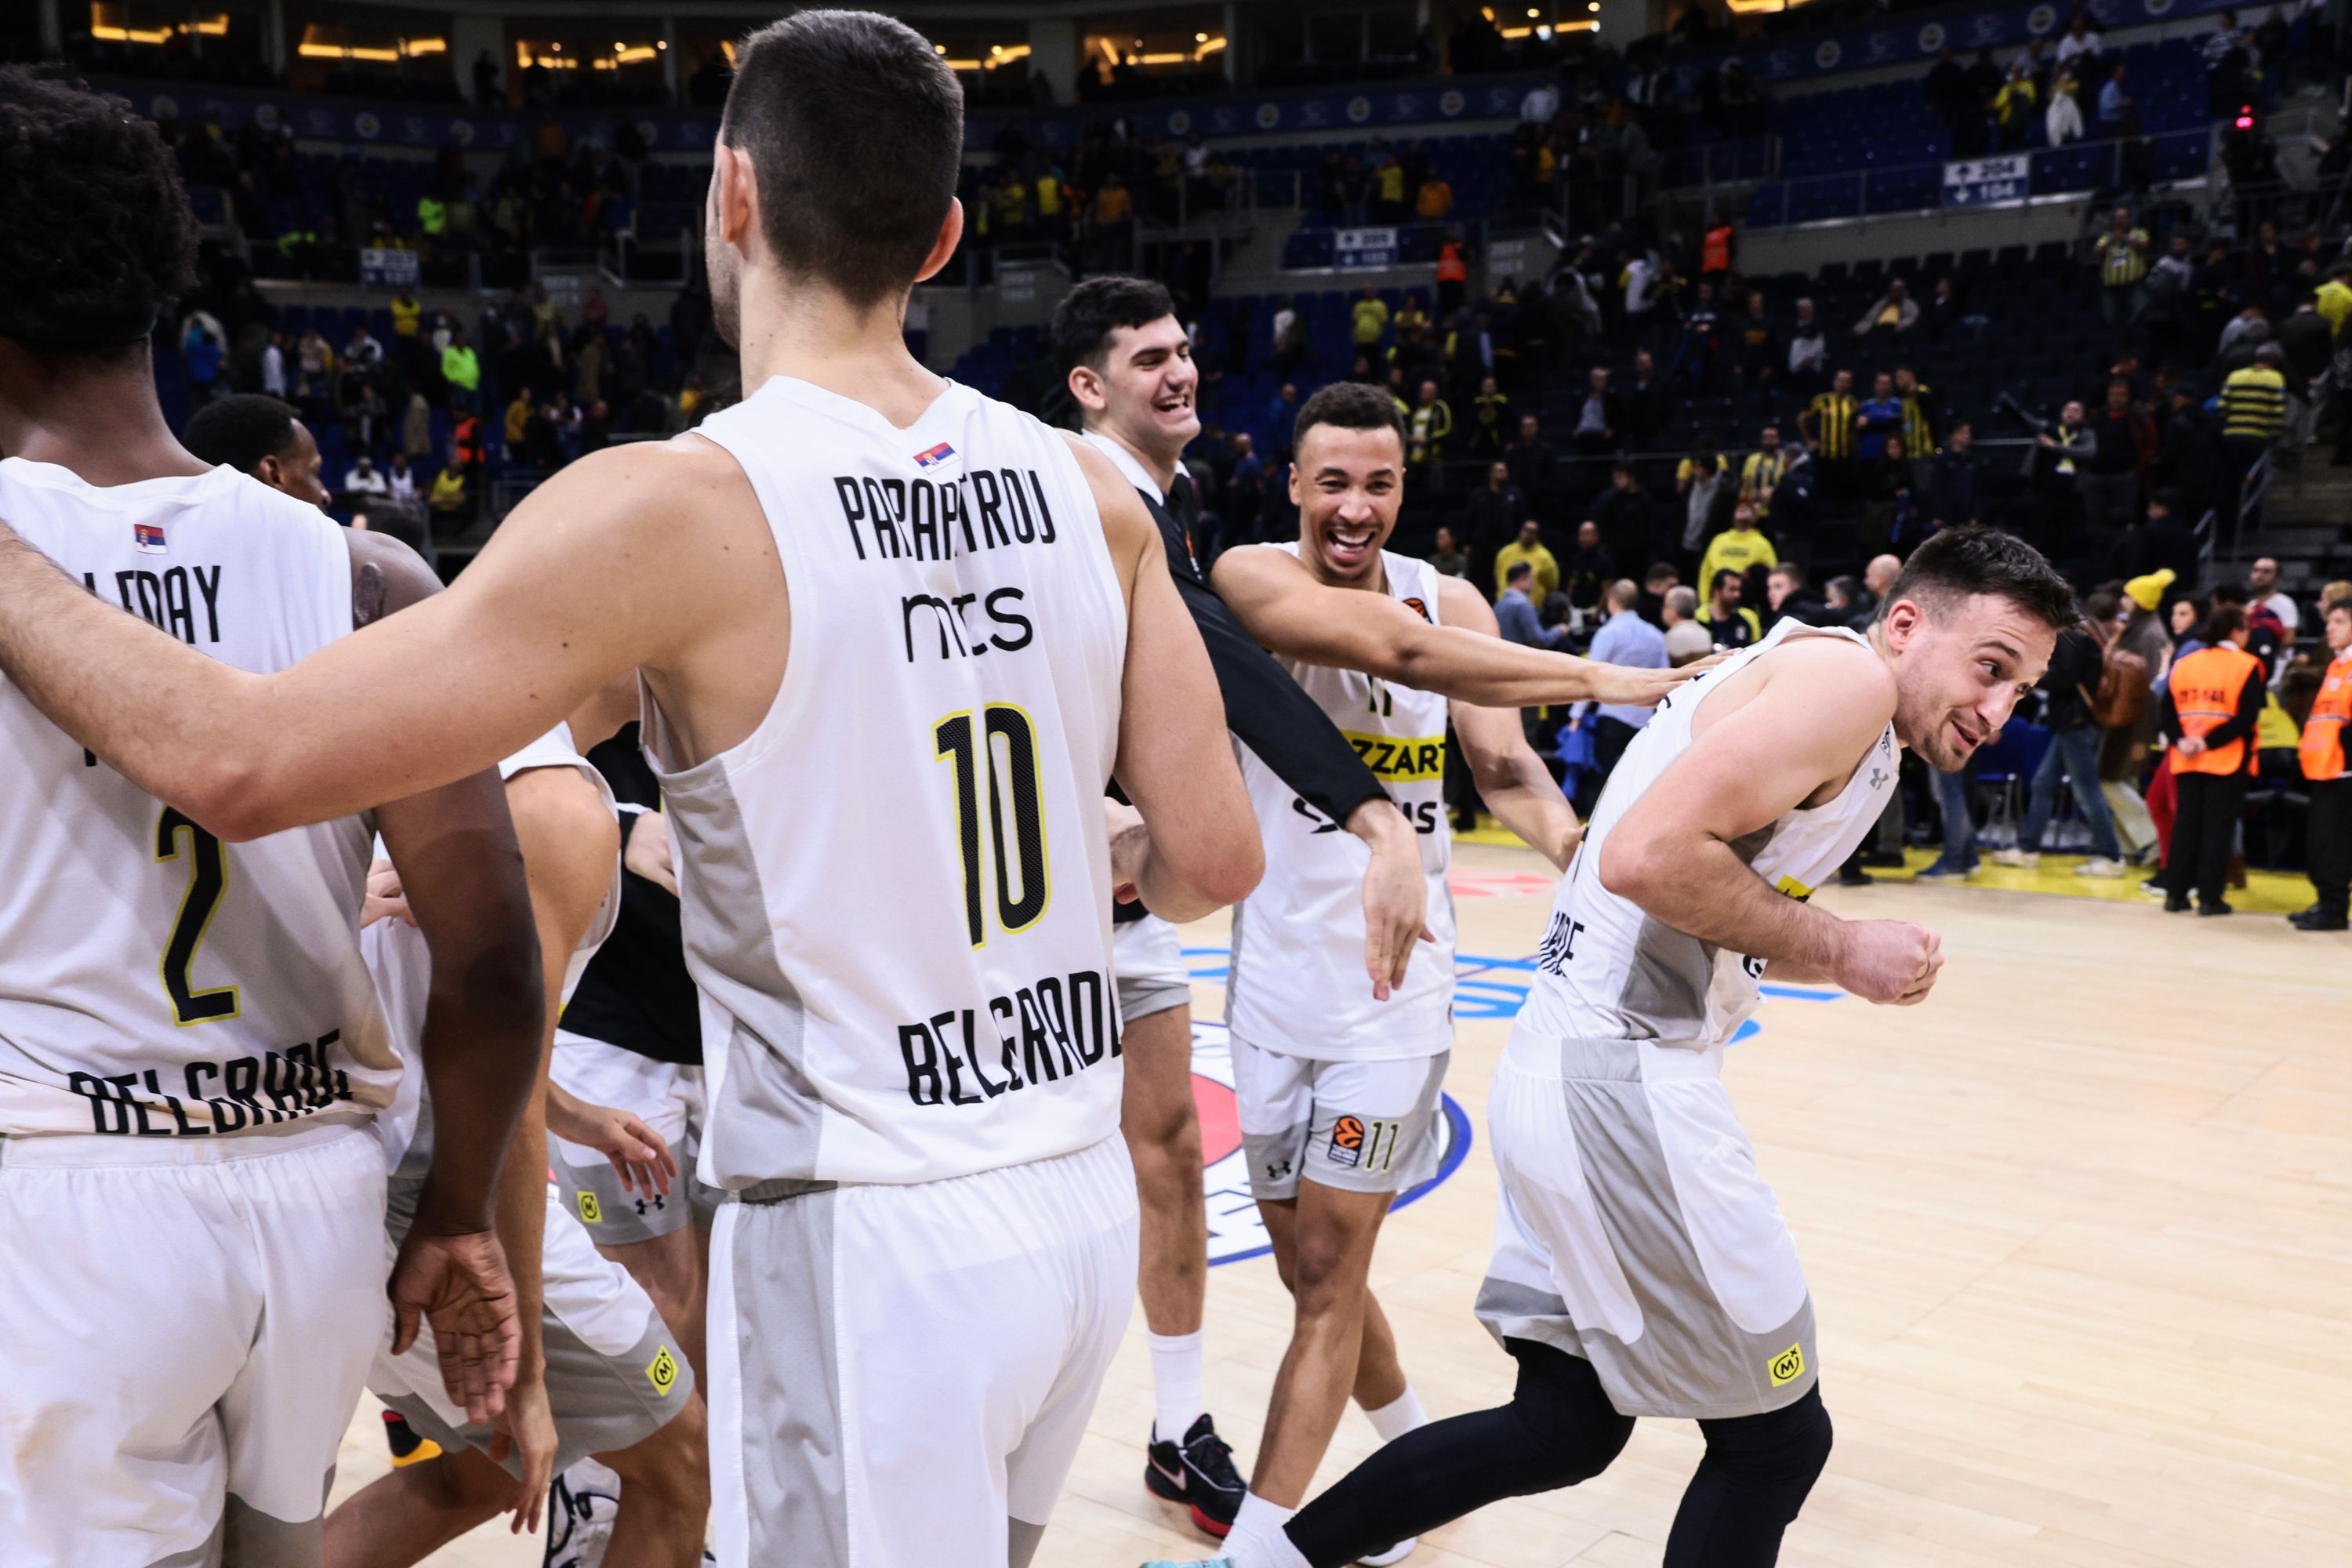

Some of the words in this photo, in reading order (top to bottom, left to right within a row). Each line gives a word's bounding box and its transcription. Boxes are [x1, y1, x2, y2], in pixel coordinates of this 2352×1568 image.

[84, 565, 221, 644] EDAY
[931, 702, 1051, 951] 10
[157, 804, 239, 1027] 2
[1365, 1120, 1401, 1173] 11
